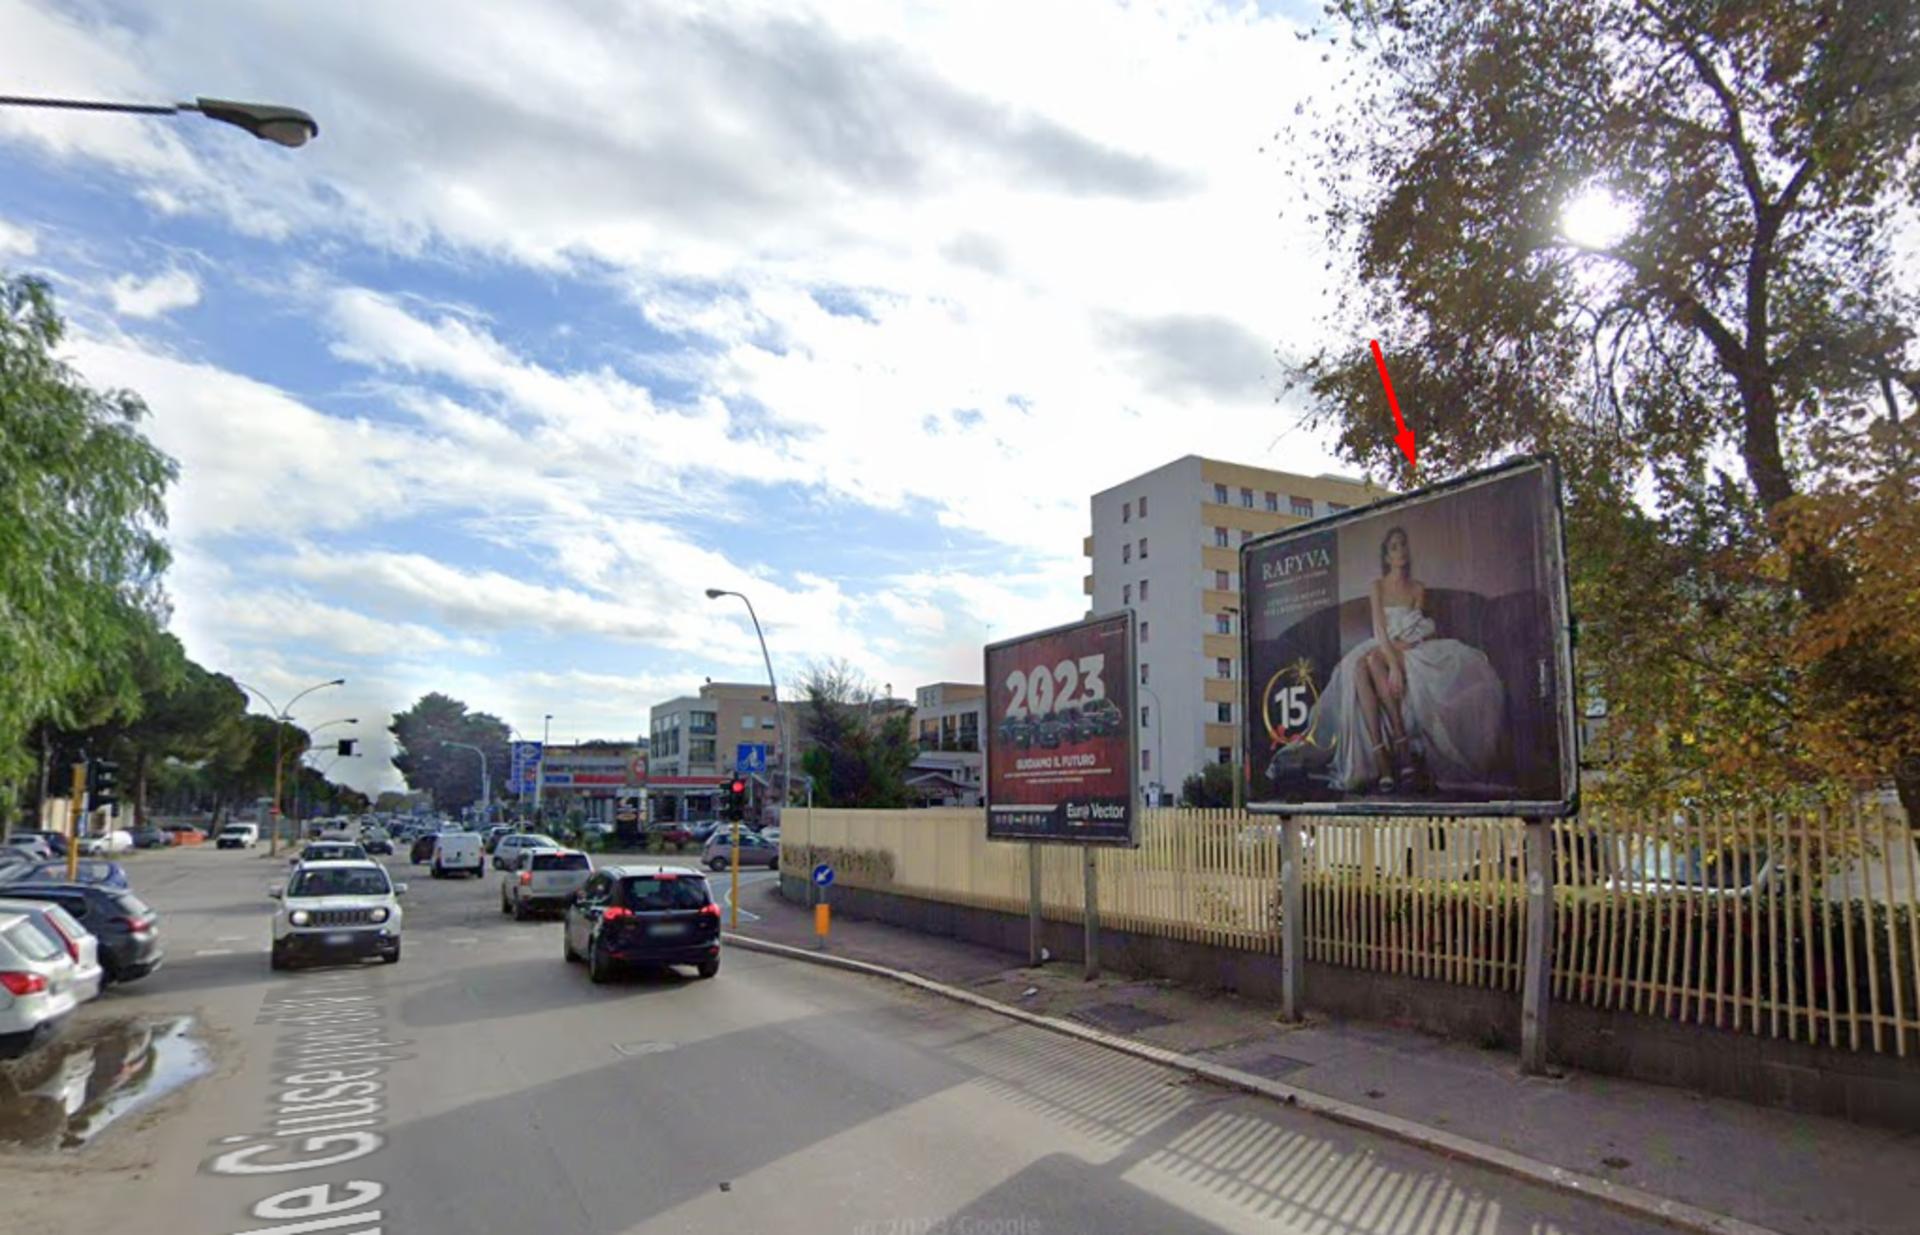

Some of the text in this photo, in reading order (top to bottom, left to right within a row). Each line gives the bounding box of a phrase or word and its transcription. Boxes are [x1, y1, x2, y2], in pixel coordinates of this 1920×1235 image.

[1262, 548, 1331, 581] RAFYVA
[1004, 653, 1106, 721] 2023
[1274, 685, 1308, 730] 15
[1062, 753, 1096, 767] FUTURO
[1090, 802, 1126, 819] Vector
